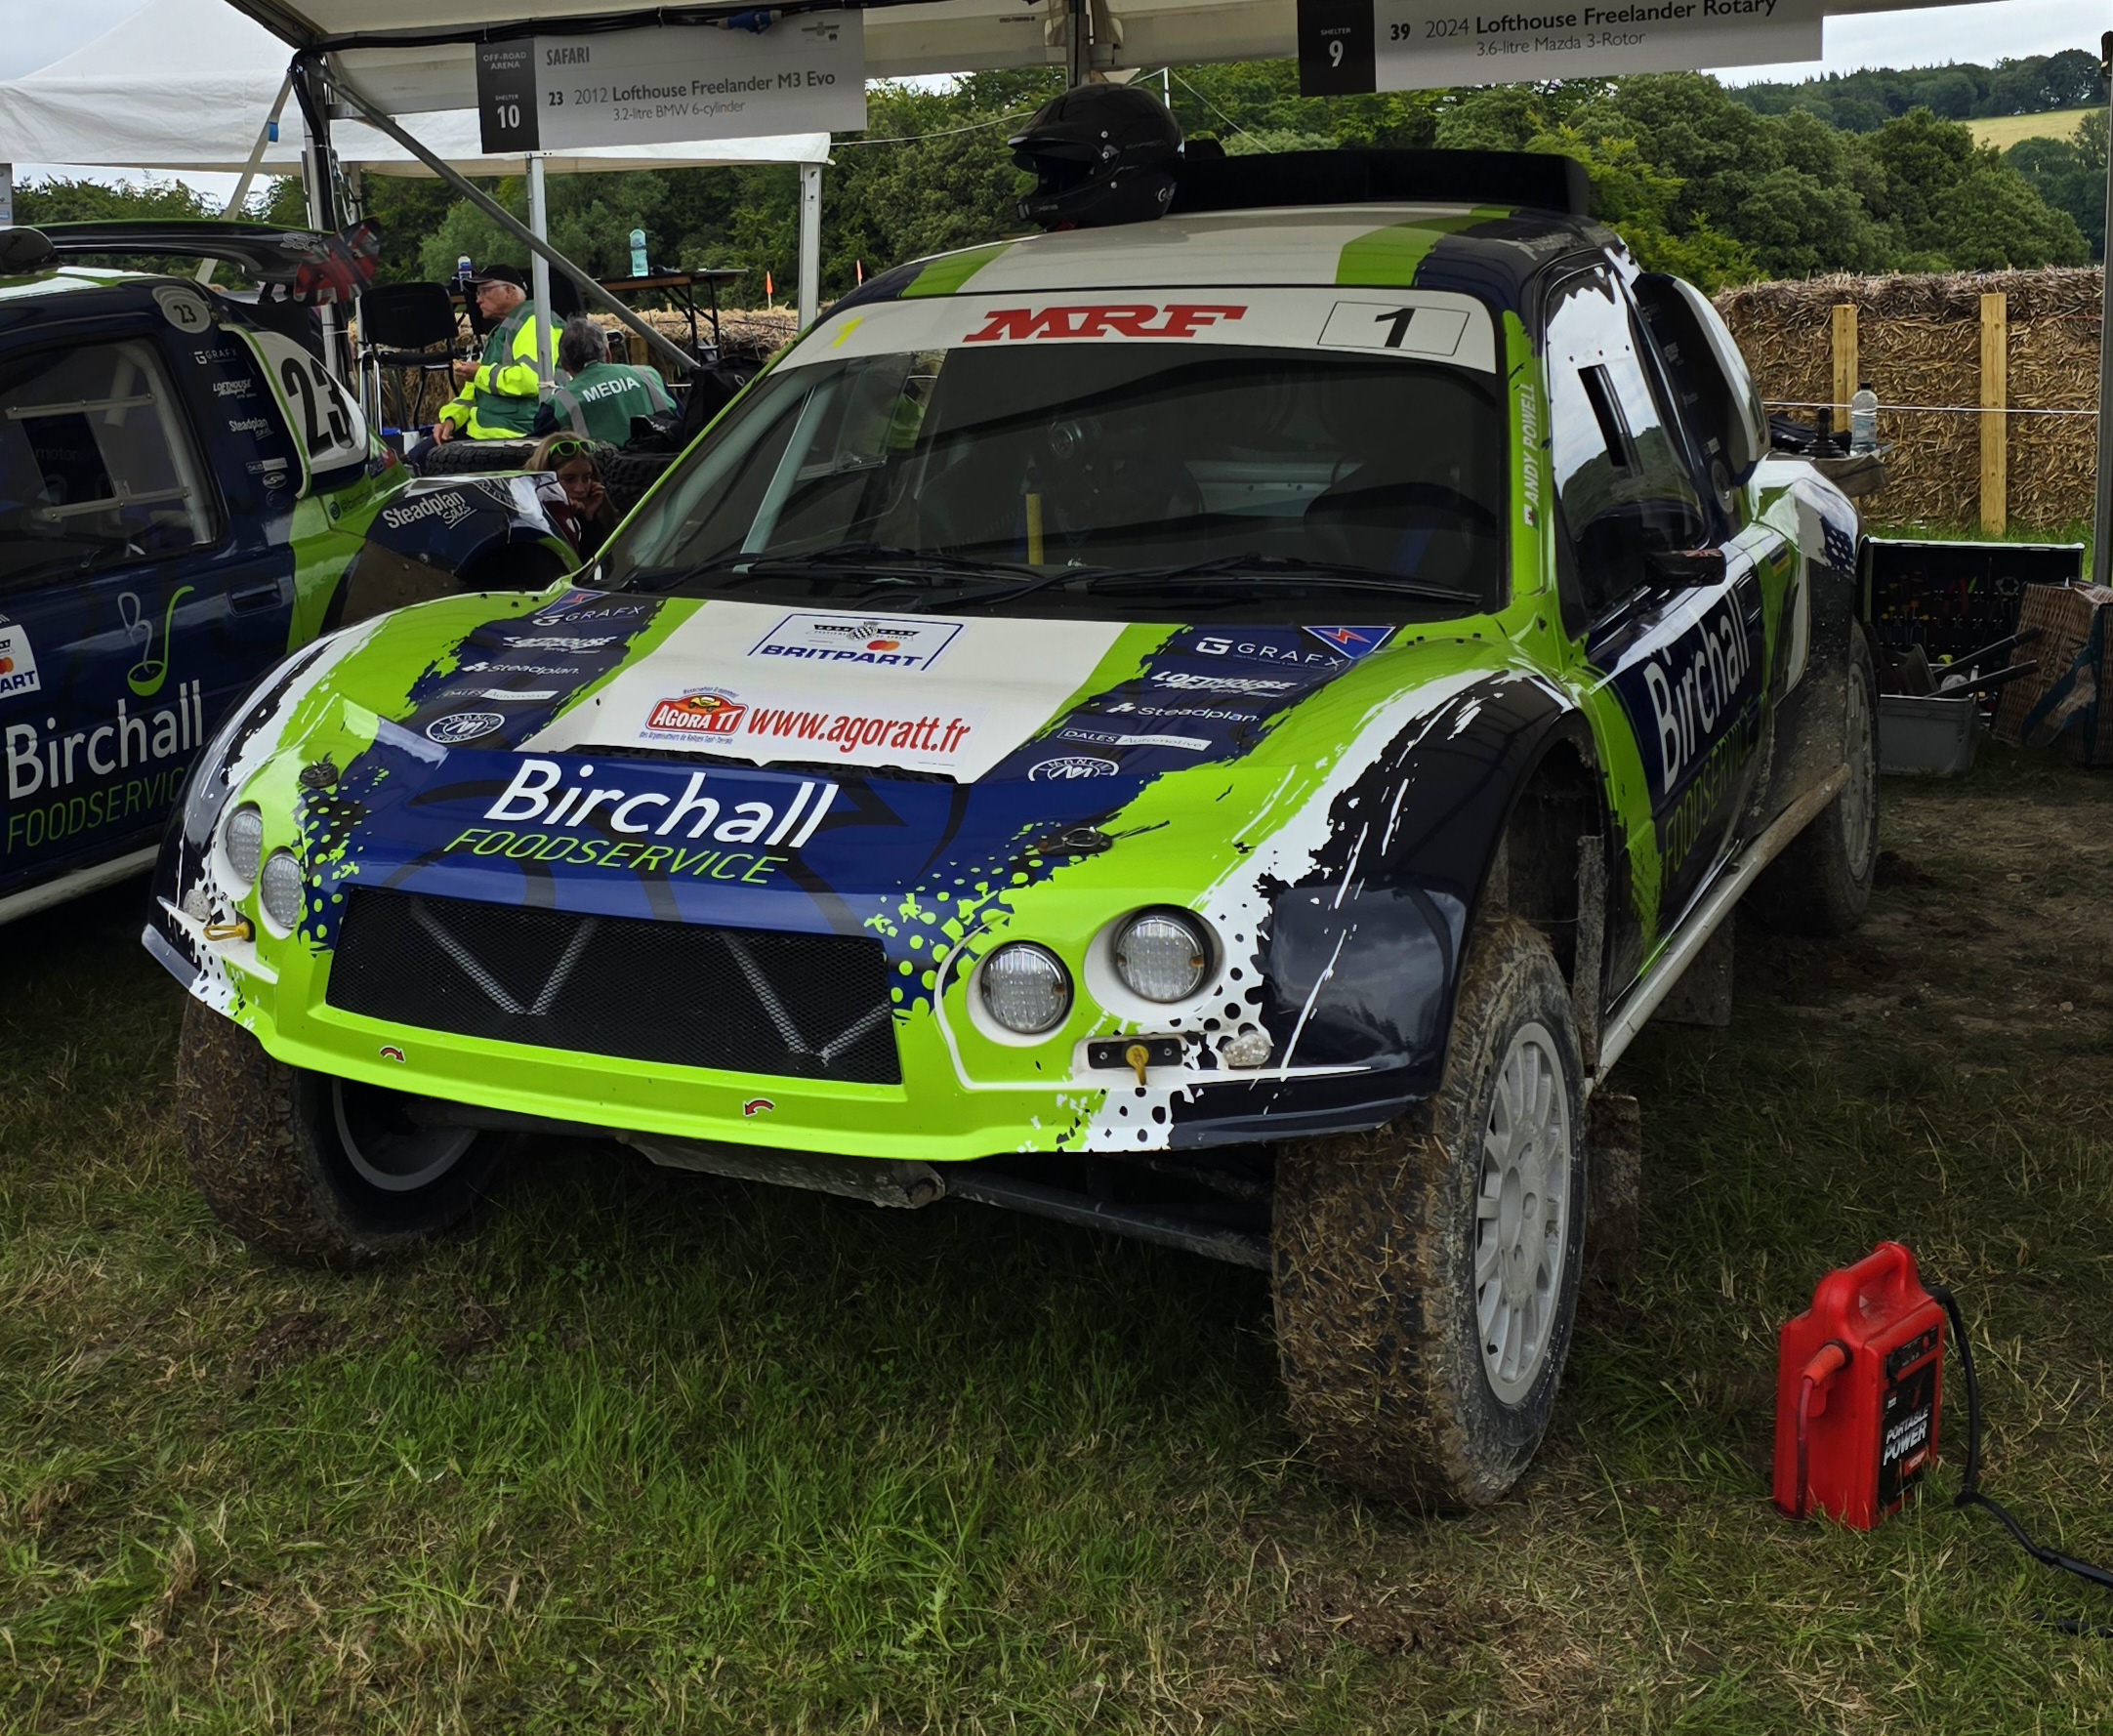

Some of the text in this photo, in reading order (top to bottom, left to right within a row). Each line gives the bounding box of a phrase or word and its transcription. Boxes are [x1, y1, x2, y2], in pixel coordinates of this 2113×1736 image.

[1320, 27, 1351, 36] SHELTER
[1389, 0, 1778, 41] 39 2024 Lofthouse Freelander Rotary
[482, 51, 527, 62] OFF-ROAD
[546, 46, 591, 65] SAFARI
[1328, 40, 1345, 67] 9
[1476, 30, 1646, 57] 3.6-litre Mazda 3-Rotor
[490, 61, 520, 70] ARENA
[548, 70, 836, 106] 23 2012 Lofthouse Freelander M3 Evo
[497, 104, 520, 128] 10
[613, 100, 746, 121] 3.2-litre BMW 6-cylinder
[173, 304, 198, 324] 23
[962, 304, 1249, 344] MRF
[832, 316, 864, 349] 1
[1374, 307, 1418, 349] 1
[205, 348, 238, 360] GRAFX
[582, 376, 641, 402] MEDIA
[280, 357, 355, 459] 23
[228, 417, 269, 433] Steadplan
[1519, 383, 1540, 507] ANDY POWELL
[382, 489, 466, 529] Steadplan
[564, 605, 645, 622] GRAFX
[761, 644, 924, 667] BRITPART
[1237, 642, 1345, 669] GRAFX
[1151, 670, 1299, 692] LOFTHOUSE
[1643, 586, 1751, 795] Birchall
[652, 705, 713, 729] AGORA
[6, 680, 203, 801] Birchall
[748, 708, 972, 754] www.agoratt.fr
[1063, 729, 1117, 744] DALES
[7, 765, 189, 854] FOODSERVIC
[482, 759, 840, 848] Birchall
[442, 827, 789, 885] FOODSERVICE
[1885, 1407, 1928, 1444] PORTABLE
[1883, 1421, 1927, 1467] POWER
